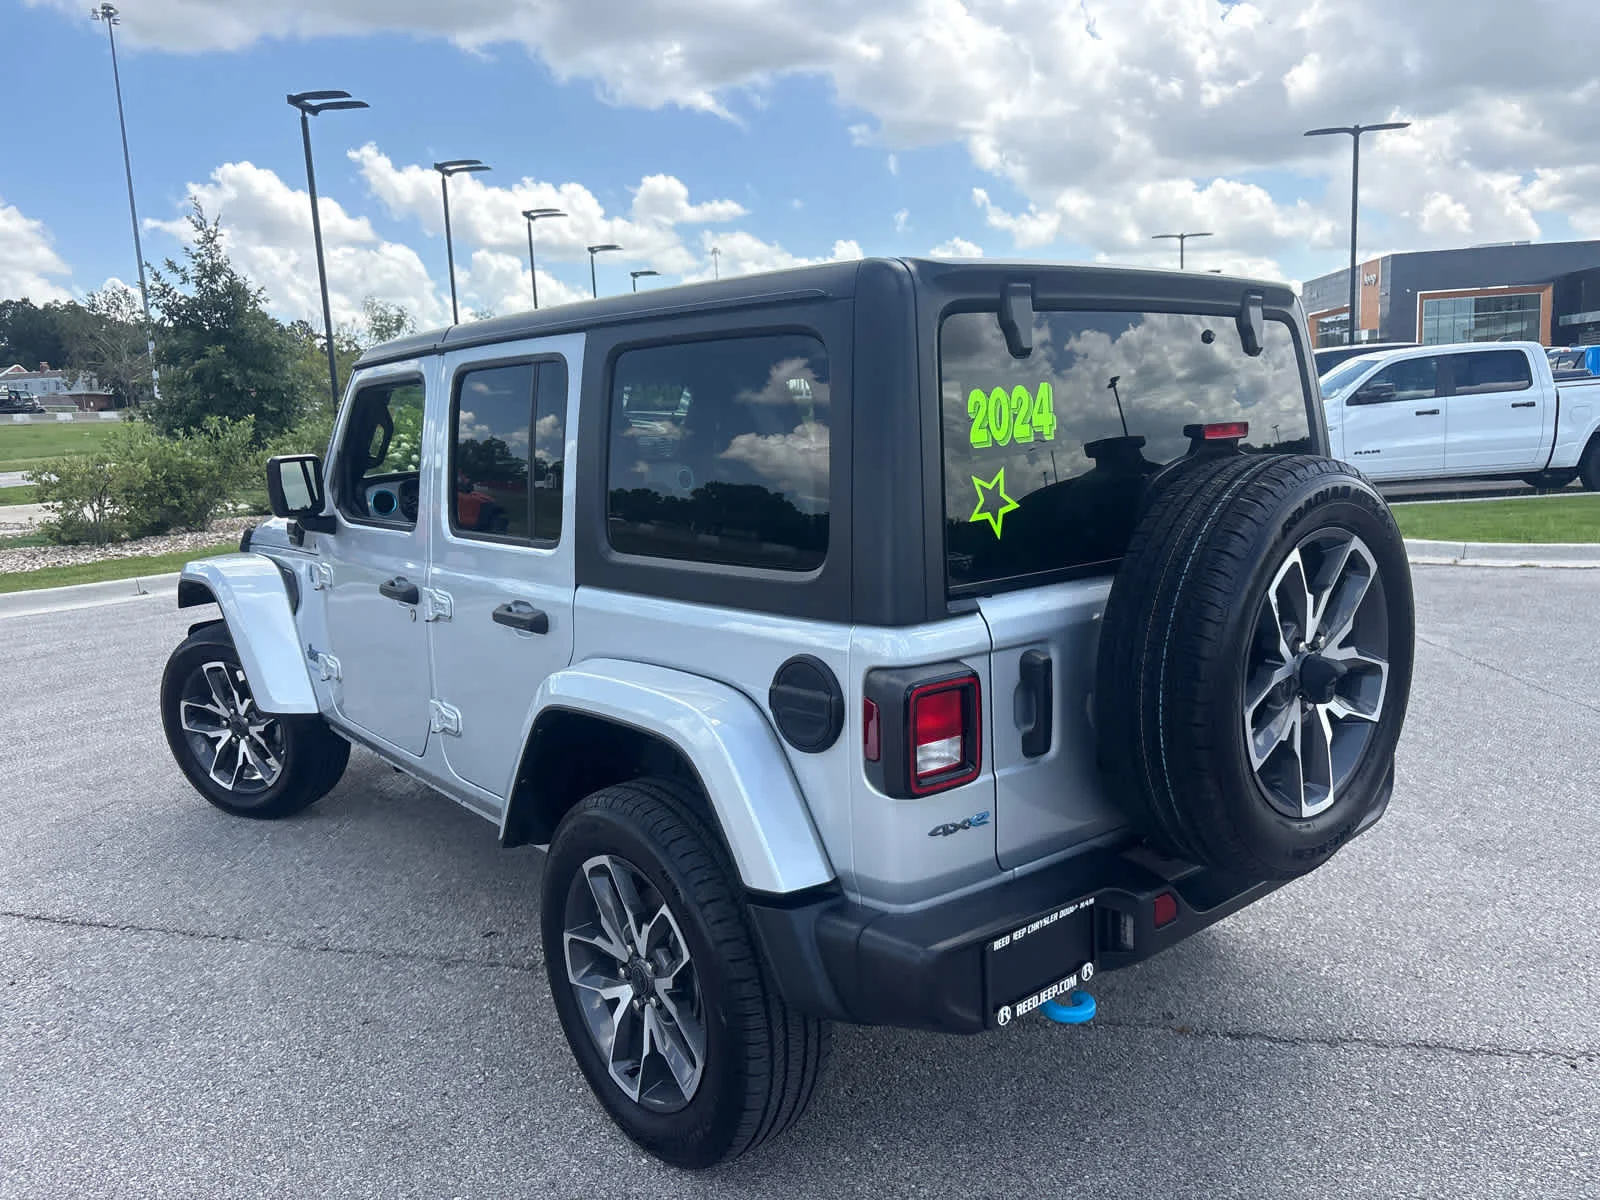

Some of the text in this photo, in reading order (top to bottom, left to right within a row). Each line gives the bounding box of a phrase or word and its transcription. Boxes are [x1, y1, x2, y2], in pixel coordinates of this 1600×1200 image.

[967, 382, 1056, 449] 2024
[993, 935, 1010, 951] REED
[1027, 912, 1059, 934] CHRYSLER
[1016, 974, 1077, 1017] REEDJEEP.COM
